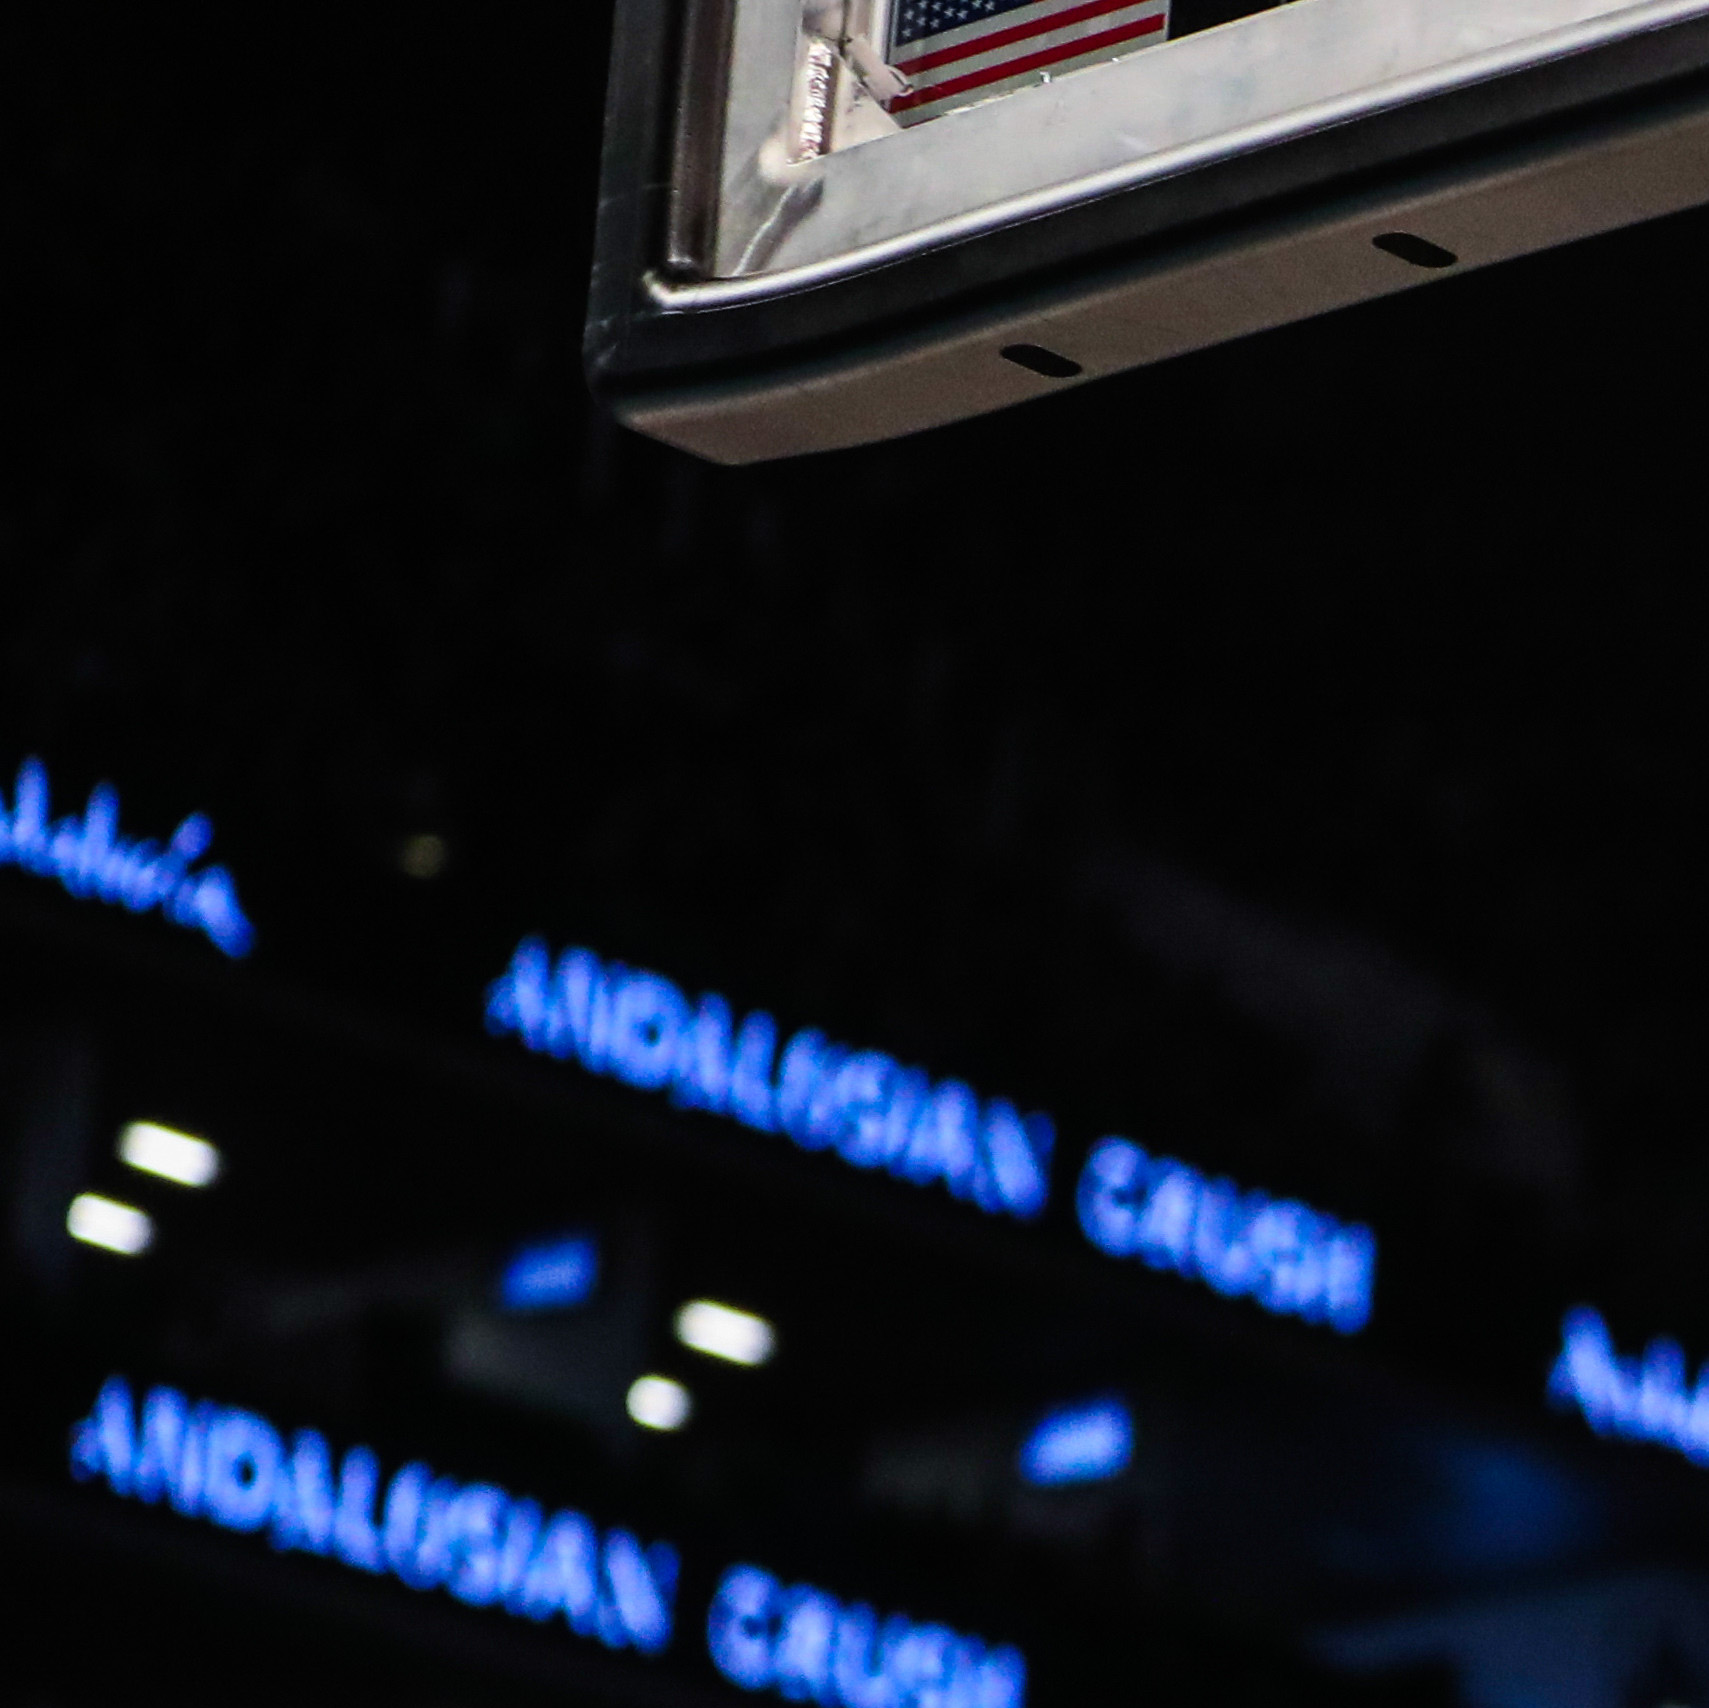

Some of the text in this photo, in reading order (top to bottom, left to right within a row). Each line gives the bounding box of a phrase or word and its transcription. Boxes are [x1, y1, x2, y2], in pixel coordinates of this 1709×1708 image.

[485, 936, 1377, 1334] ANDALUSIAN CRUSH
[71, 1377, 680, 1653] ANDALUSIAN
